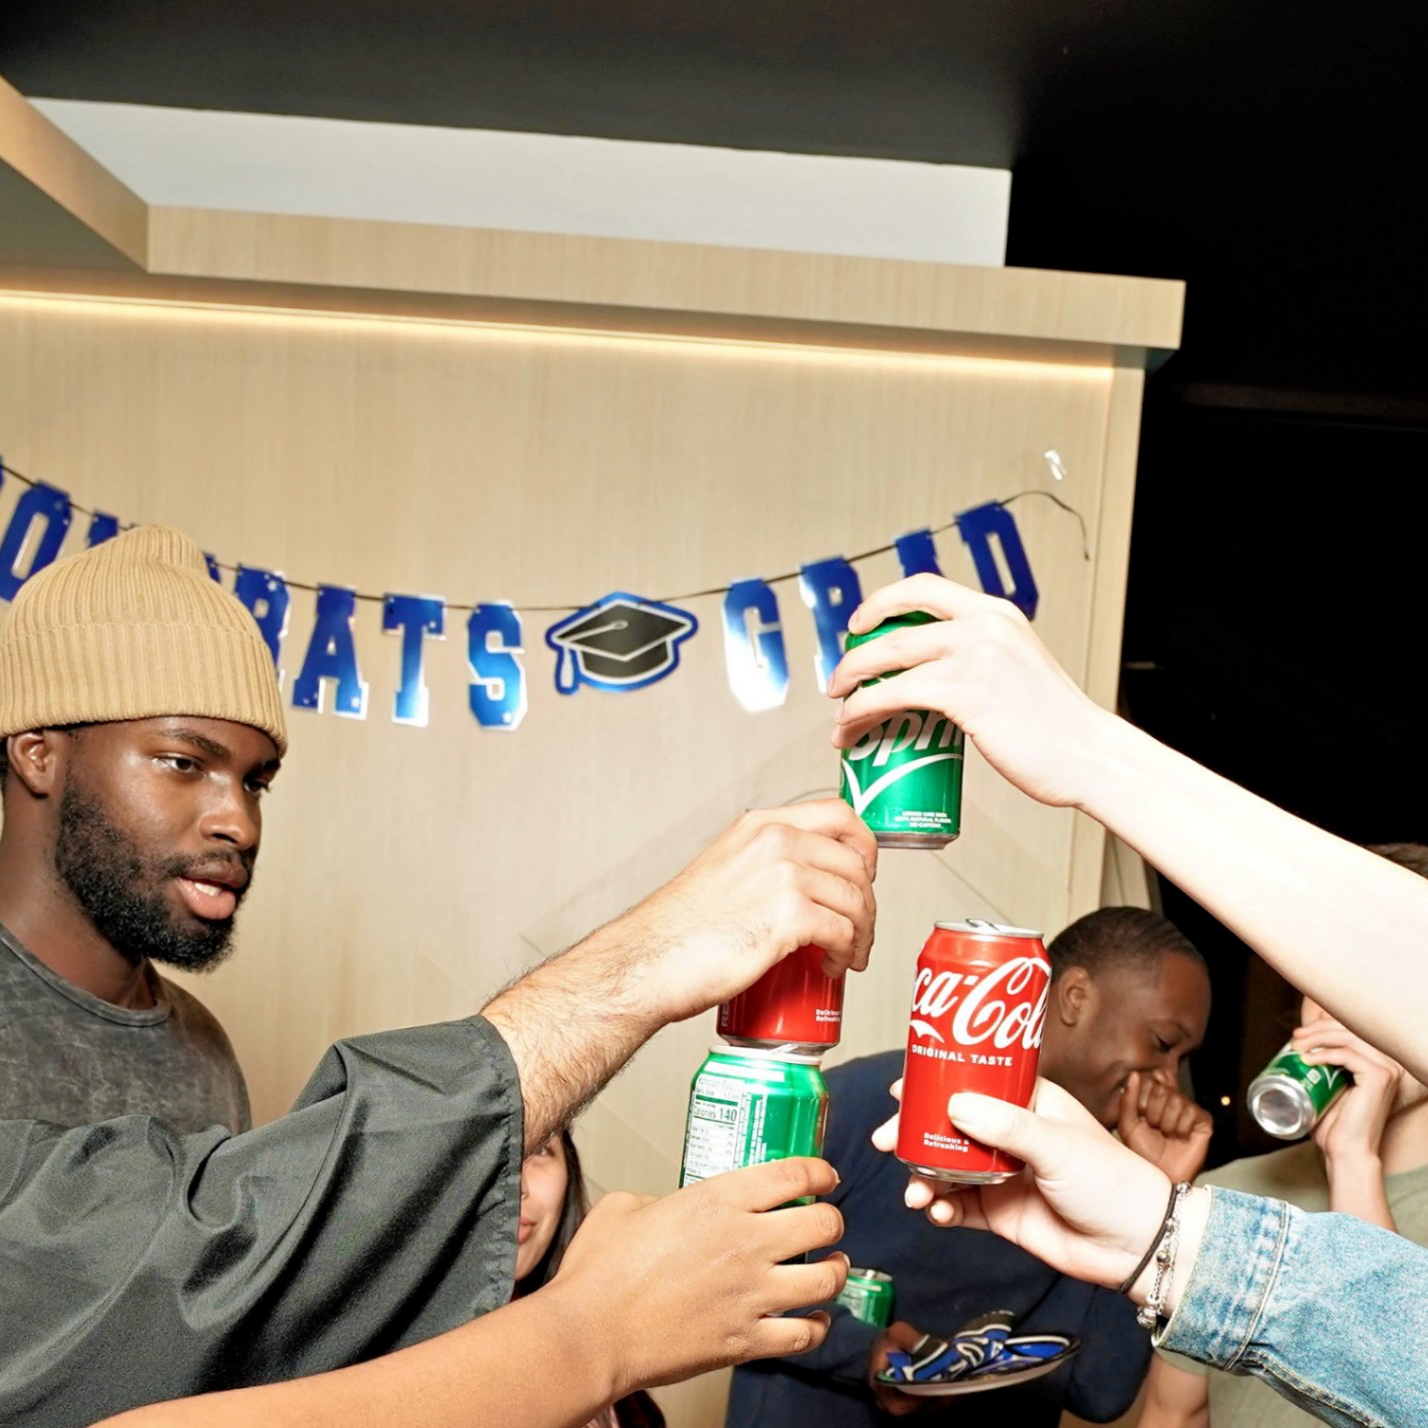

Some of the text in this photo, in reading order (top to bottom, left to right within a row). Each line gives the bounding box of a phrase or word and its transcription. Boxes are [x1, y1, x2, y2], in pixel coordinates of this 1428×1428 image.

[722, 498, 1039, 712] GRD
[912, 1044, 1013, 1067] ORIGINAL TASTE
[719, 1107, 738, 1122] 140
[923, 1132, 962, 1145] Delicious
[923, 1139, 969, 1153] Refreshing
